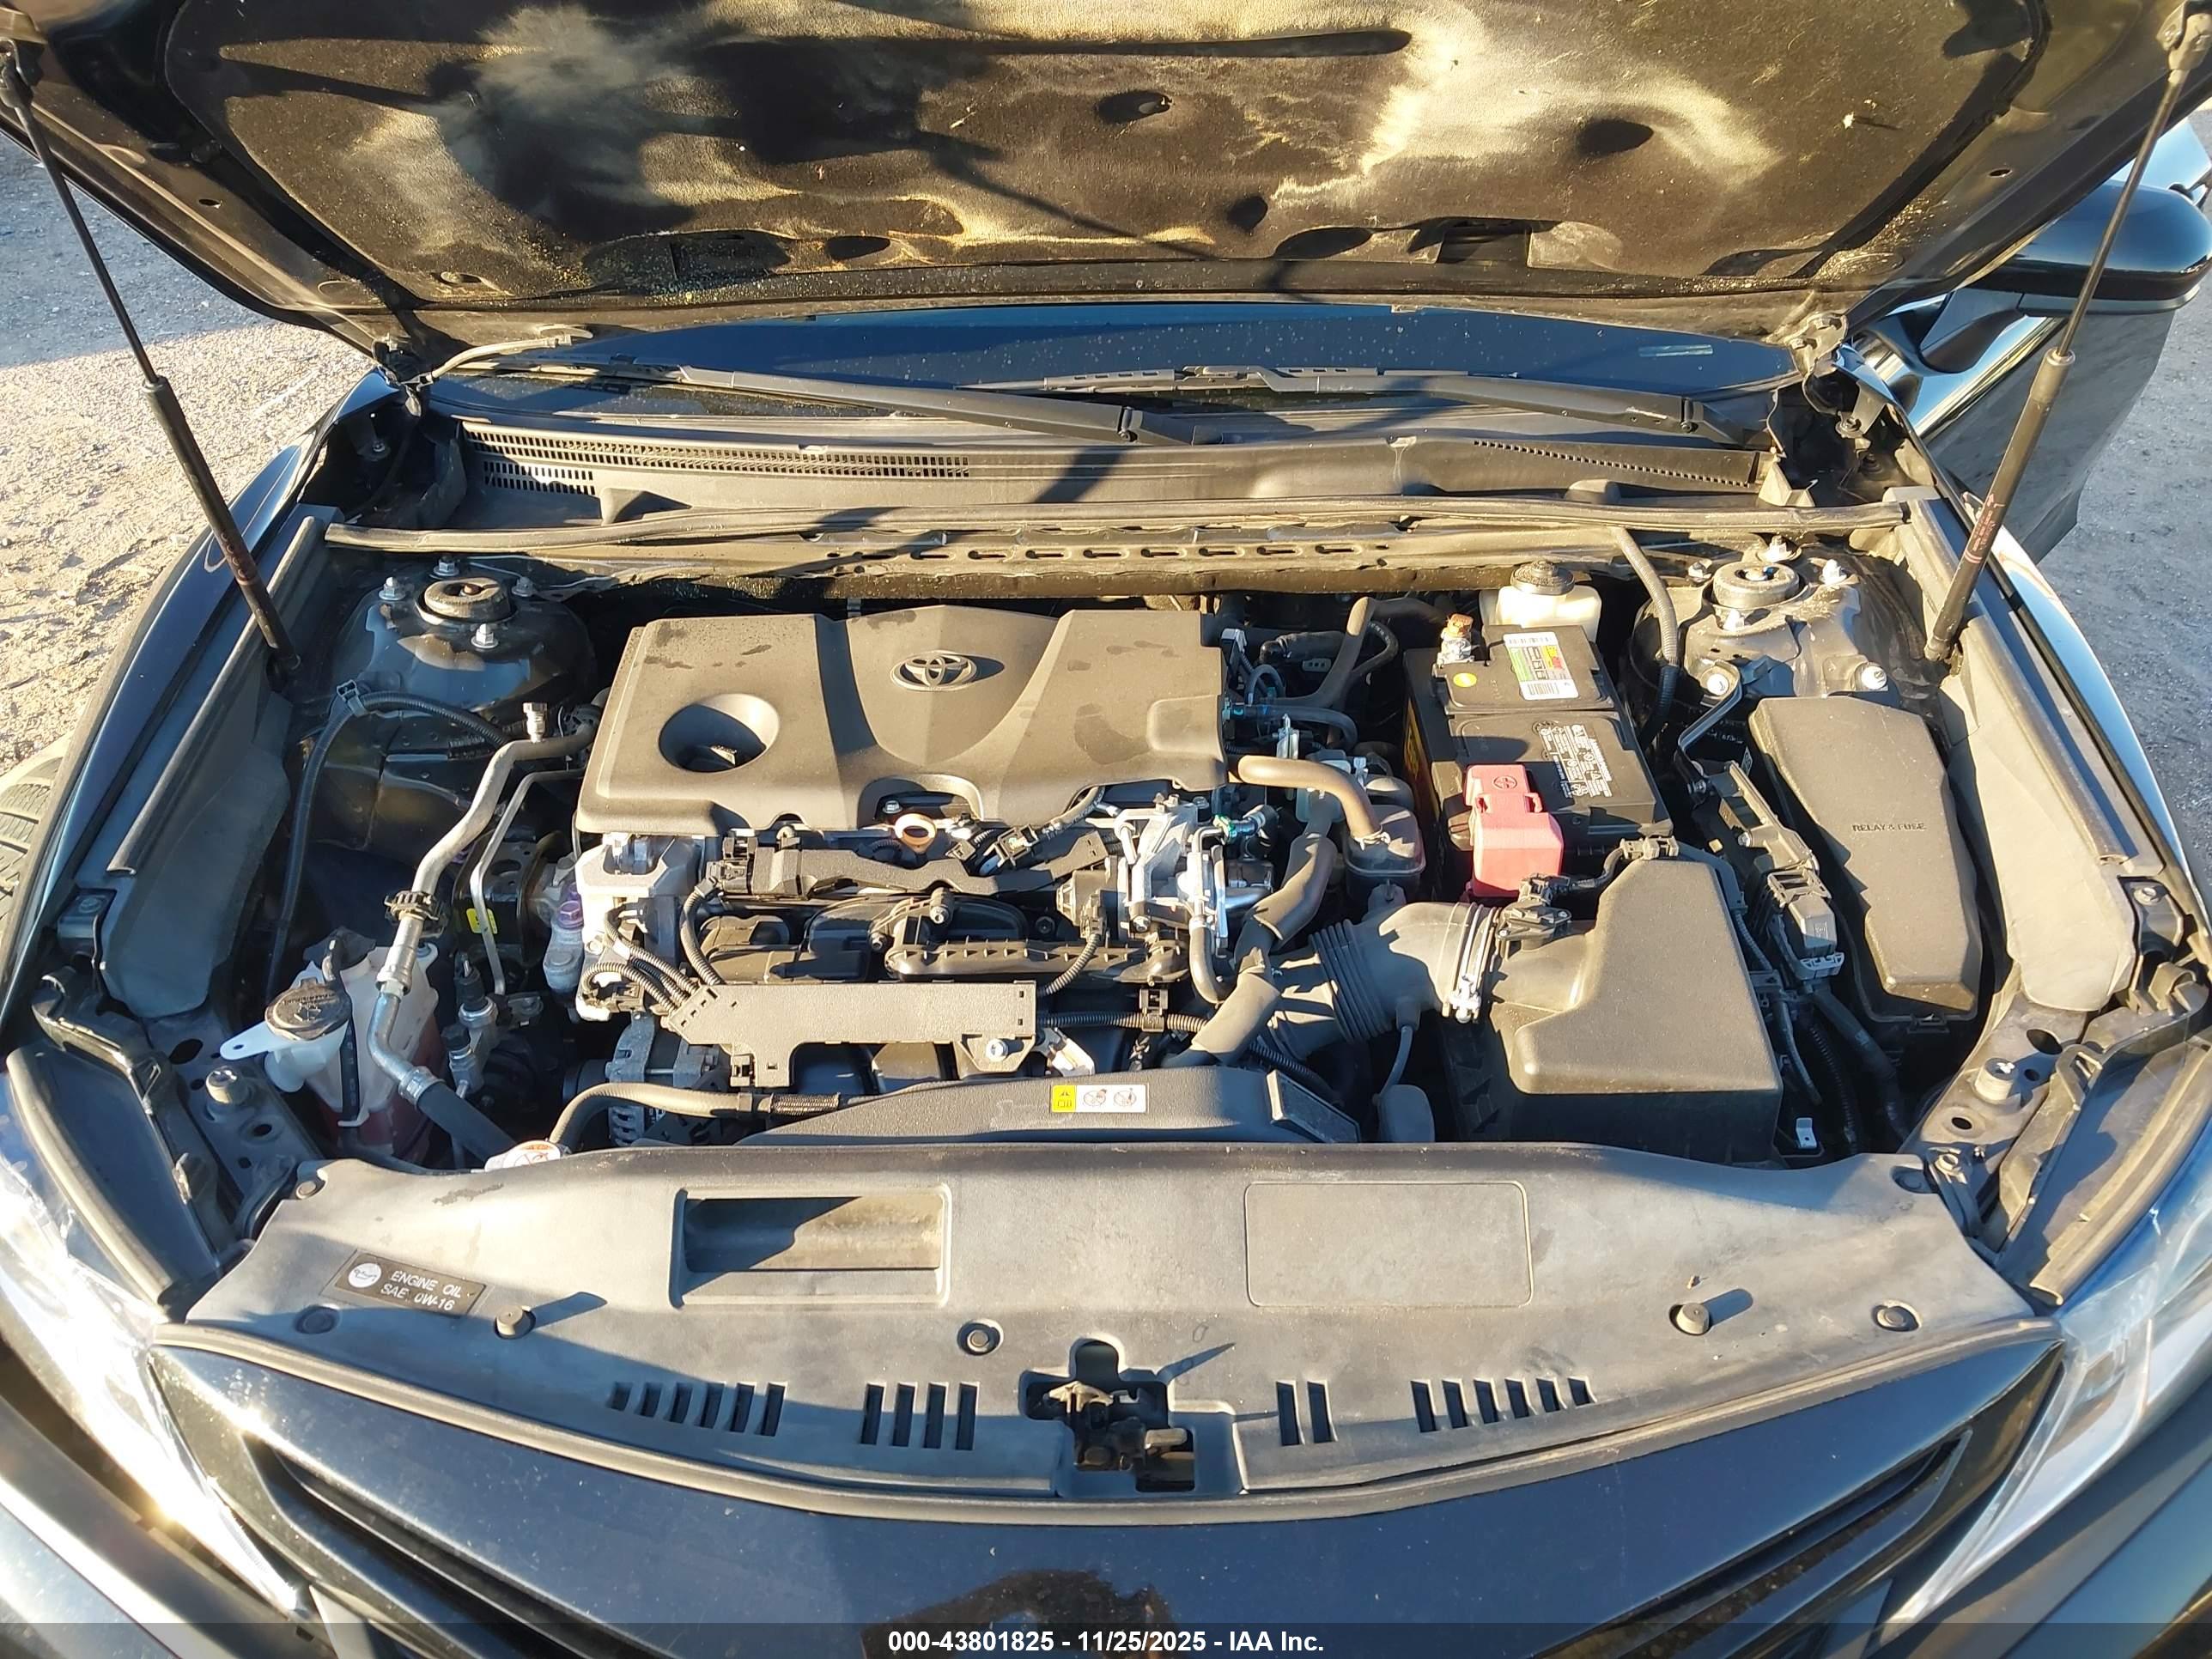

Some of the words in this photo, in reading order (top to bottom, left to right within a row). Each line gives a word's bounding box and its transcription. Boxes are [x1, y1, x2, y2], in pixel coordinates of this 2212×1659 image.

[1851, 823, 1886, 833] RELAY
[1897, 823, 1926, 831] FUSE
[380, 1284, 409, 1298] SAE
[414, 1292, 455, 1310] 0W-16
[391, 1271, 438, 1291] ENGINE
[443, 1285, 461, 1297] OIL
